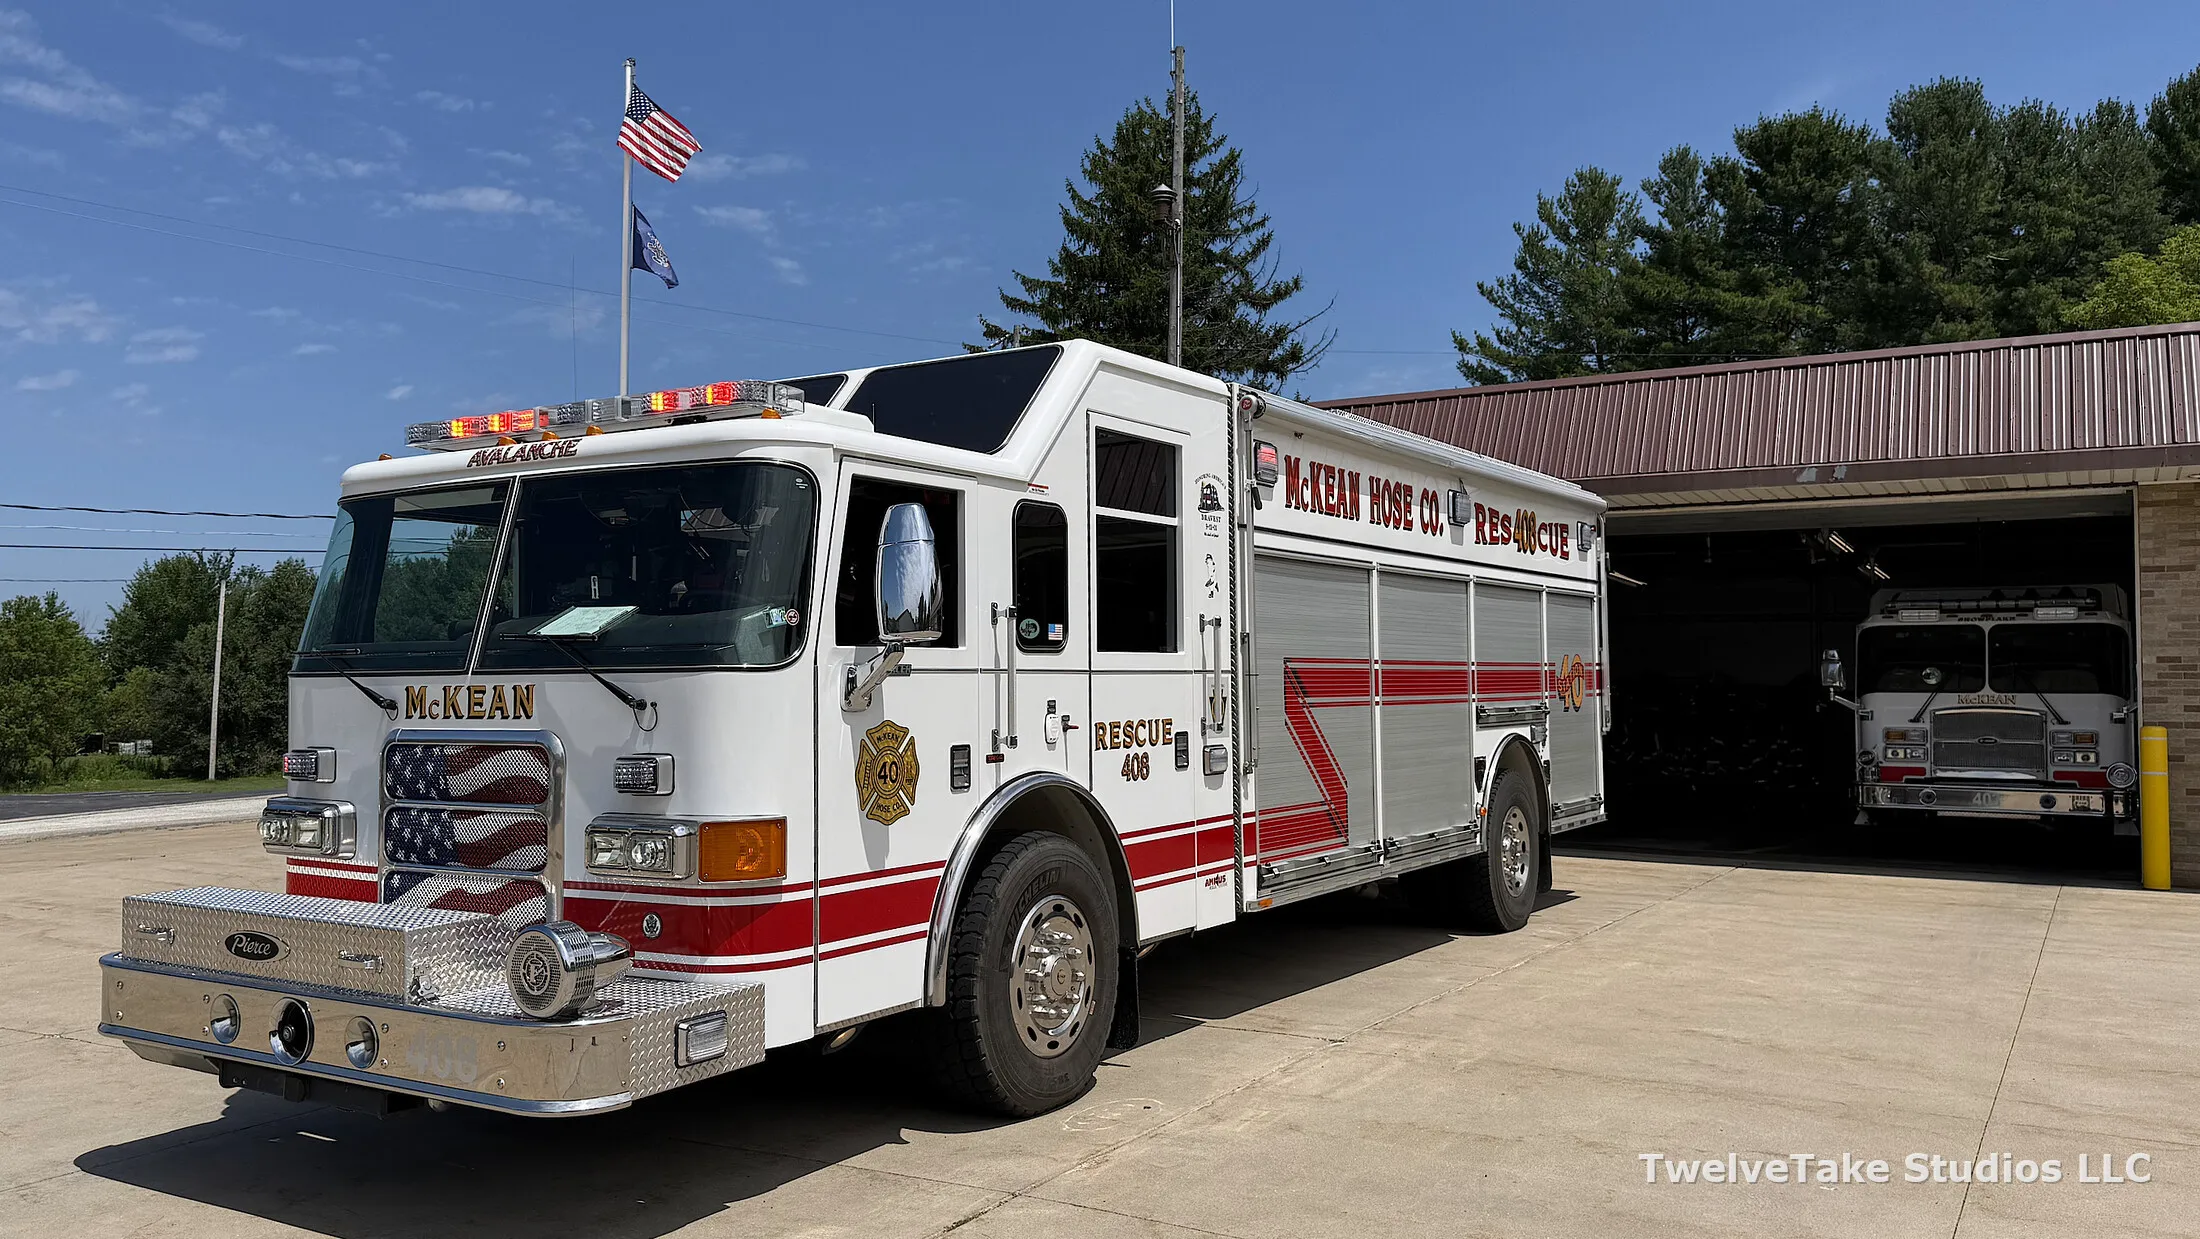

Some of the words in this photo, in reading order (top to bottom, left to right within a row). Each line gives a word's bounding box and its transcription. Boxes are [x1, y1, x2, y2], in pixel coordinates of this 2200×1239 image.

[467, 439, 582, 468] AVALANCHE
[1284, 455, 1360, 521] McKEAN
[1368, 475, 1414, 531] HOSE
[1419, 487, 1444, 537] CO.
[1558, 653, 1584, 712] 40
[404, 684, 536, 719] McKEAN
[1957, 694, 2017, 705] McKEAN
[1094, 718, 1173, 751] RESCUE
[878, 761, 899, 785] 40
[1121, 752, 1150, 781] 408
[876, 803, 891, 813] HOSE
[231, 934, 272, 955] Pierce
[405, 1030, 478, 1083] 408
